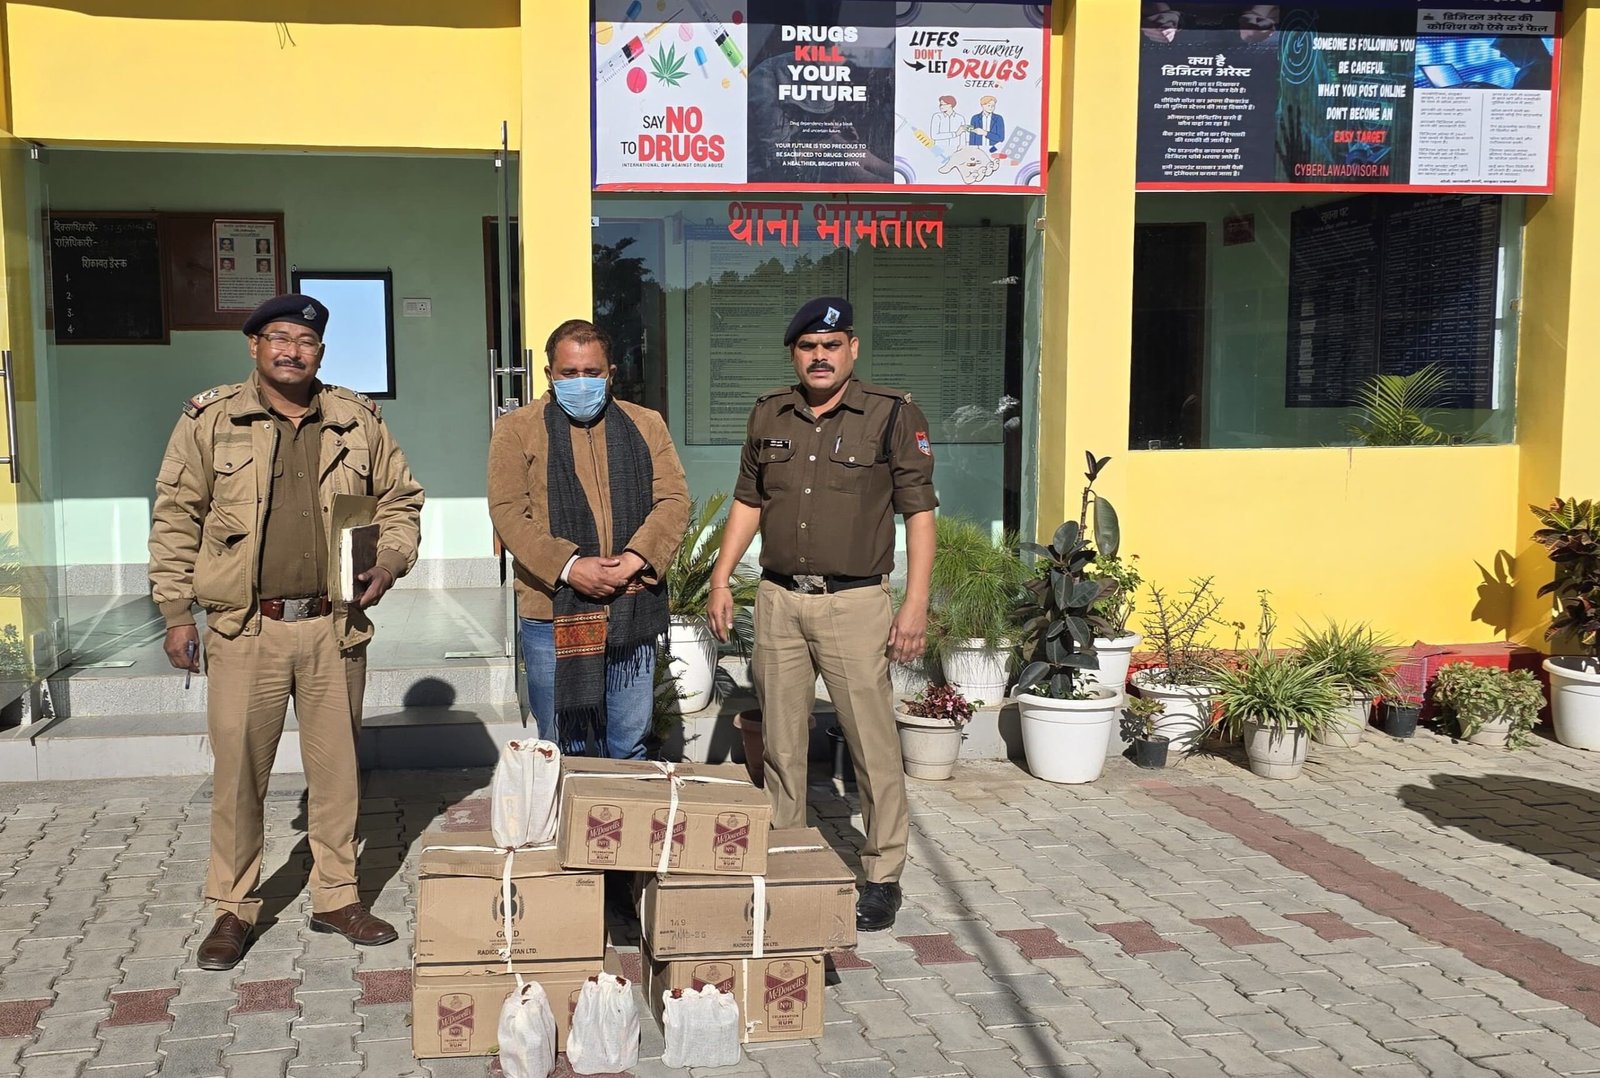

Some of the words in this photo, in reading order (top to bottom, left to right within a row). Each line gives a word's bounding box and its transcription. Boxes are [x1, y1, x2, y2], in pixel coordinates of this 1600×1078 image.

[1442, 12, 1484, 21] डिजिटल
[1487, 12, 1516, 22] अरेस्ट
[1518, 14, 1534, 22] की
[782, 25, 858, 42] DRUGS
[1427, 22, 1466, 31] कोशिश
[1468, 22, 1484, 31] को
[1486, 23, 1504, 32] ऐसे
[1506, 23, 1524, 32] करें
[1526, 24, 1548, 32] फेल
[909, 30, 960, 48] LIFES
[1312, 37, 1348, 51] SOMEONE
[1349, 38, 1356, 51] IS
[1358, 38, 1398, 52] FOLLOWING
[1400, 38, 1416, 52] YOU
[795, 45, 846, 62] KILL
[914, 49, 943, 60] DON'T
[972, 44, 1024, 60] JOURNEY
[1188, 56, 1214, 66] क्या
[1215, 54, 1226, 66] है
[1338, 60, 1350, 74] BE
[1350, 61, 1385, 74] CAREFUL
[787, 64, 851, 82] YOUR
[928, 60, 948, 74] LET
[947, 58, 1030, 80] DRUGS
[1161, 64, 1214, 76] डिजिटल
[1215, 65, 1252, 77] अरेस्ट
[778, 84, 867, 102] FUTURE
[1318, 84, 1340, 98] WHAT
[1342, 84, 1357, 98] YOU
[1358, 84, 1378, 98] POST
[1380, 84, 1406, 98] ONLINE
[642, 115, 666, 129] SAY
[666, 106, 703, 134] NO
[1326, 106, 1346, 120] DON'T
[1350, 106, 1380, 120] BECOME
[1382, 106, 1394, 120] AN
[1334, 130, 1354, 143] EASY
[1356, 130, 1388, 143] TARGET
[620, 142, 637, 155] TO
[638, 134, 725, 162] DRUGS
[1294, 163, 1389, 177] CYBERLAWADVISOR.IN
[728, 201, 803, 248] थाना
[769, 977, 805, 1000] McDowell's
